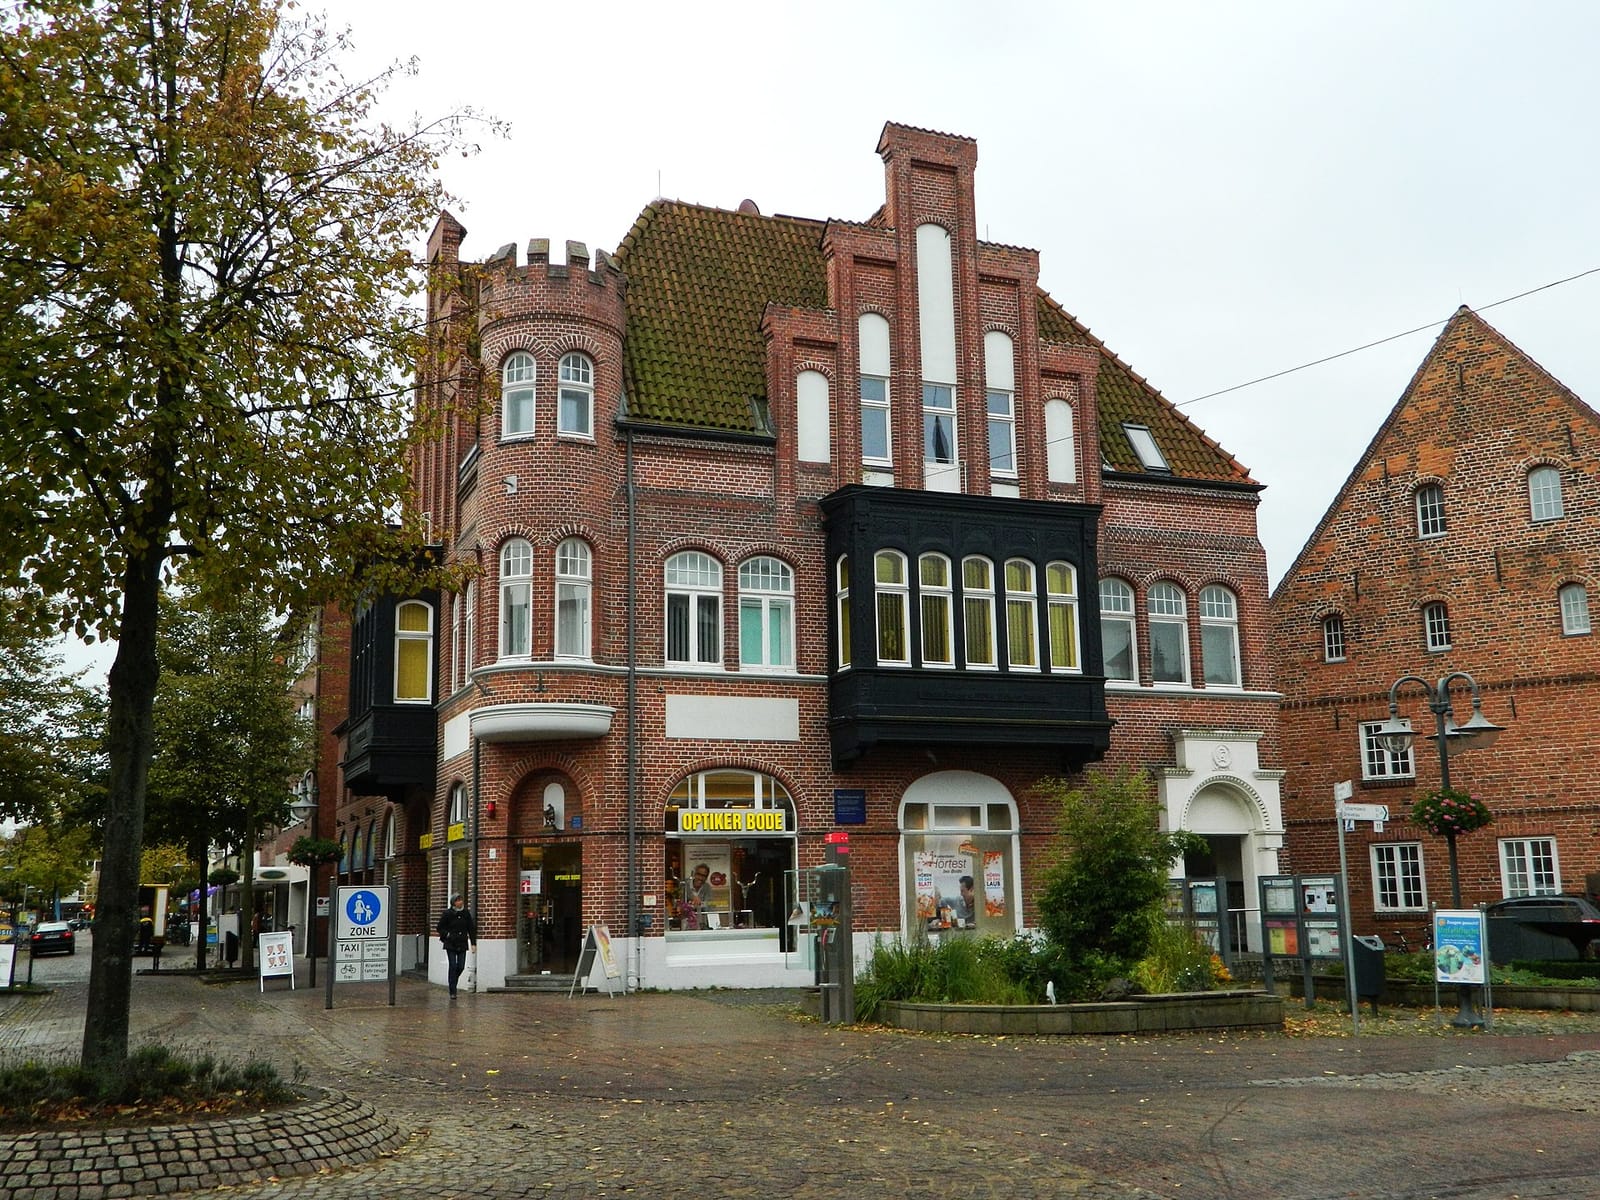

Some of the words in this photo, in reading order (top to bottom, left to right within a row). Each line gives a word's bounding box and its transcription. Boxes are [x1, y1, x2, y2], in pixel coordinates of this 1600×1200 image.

[682, 812, 742, 831] OPTIKER
[746, 812, 783, 831] BODE
[350, 926, 376, 936] ZONE
[340, 943, 360, 952] TAXI
